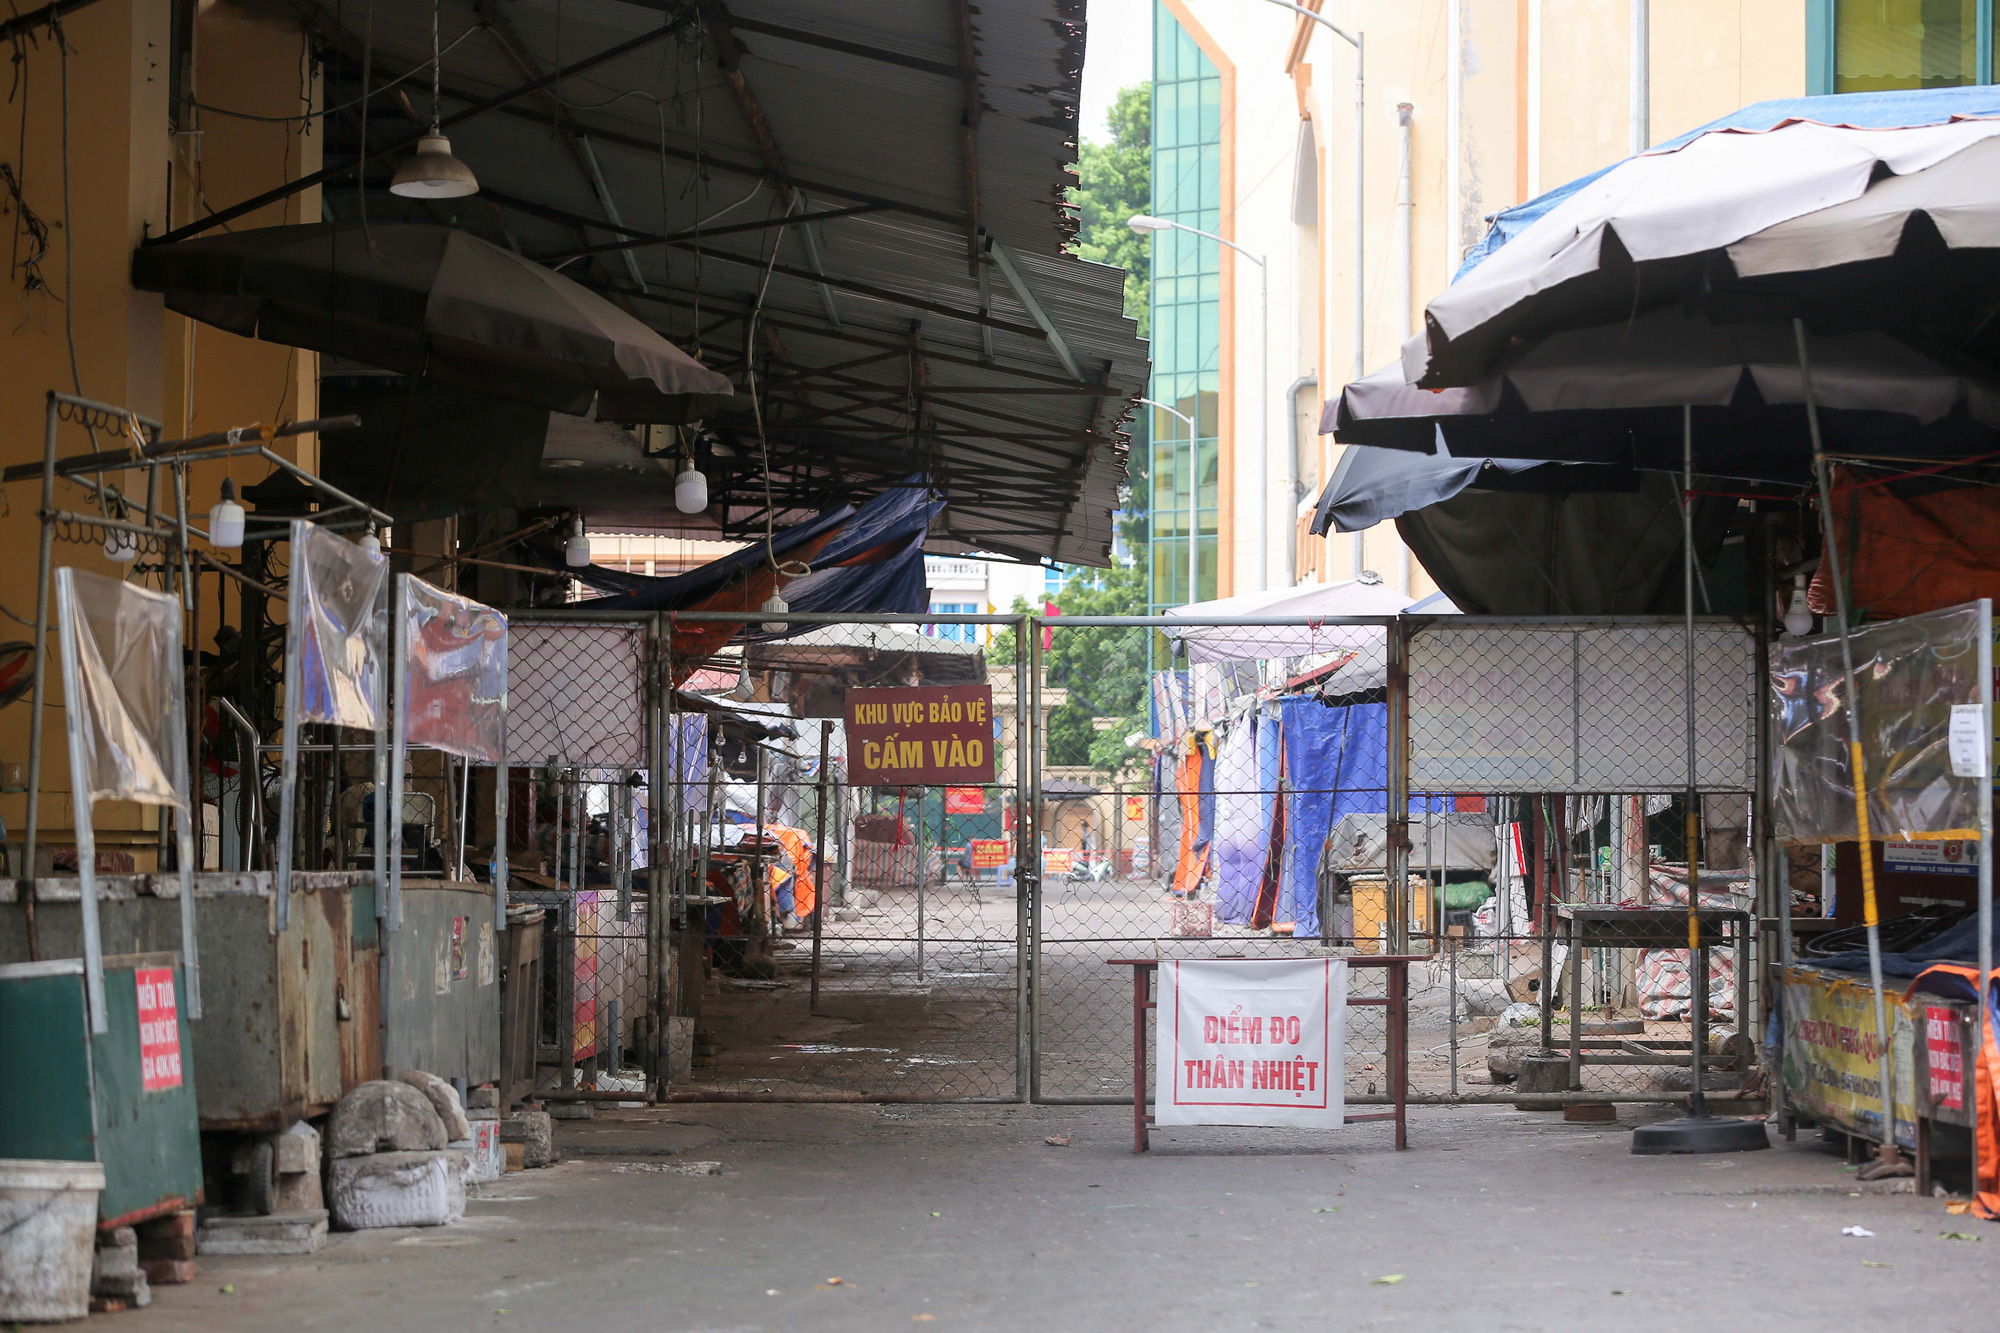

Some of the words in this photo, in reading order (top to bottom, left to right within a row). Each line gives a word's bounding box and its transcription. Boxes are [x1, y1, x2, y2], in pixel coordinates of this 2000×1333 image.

[855, 703, 888, 725] KHU
[892, 701, 924, 727] VỰC
[929, 695, 962, 723] BẢO
[966, 697, 987, 727] VỆ
[863, 732, 924, 770] CẤM
[931, 733, 984, 768] VÀO
[1203, 1005, 1262, 1044] ĐIỂM
[1270, 1016, 1300, 1045] ĐO
[1184, 1054, 1244, 1089] THÂN
[1252, 1055, 1319, 1097] NHIỆT
